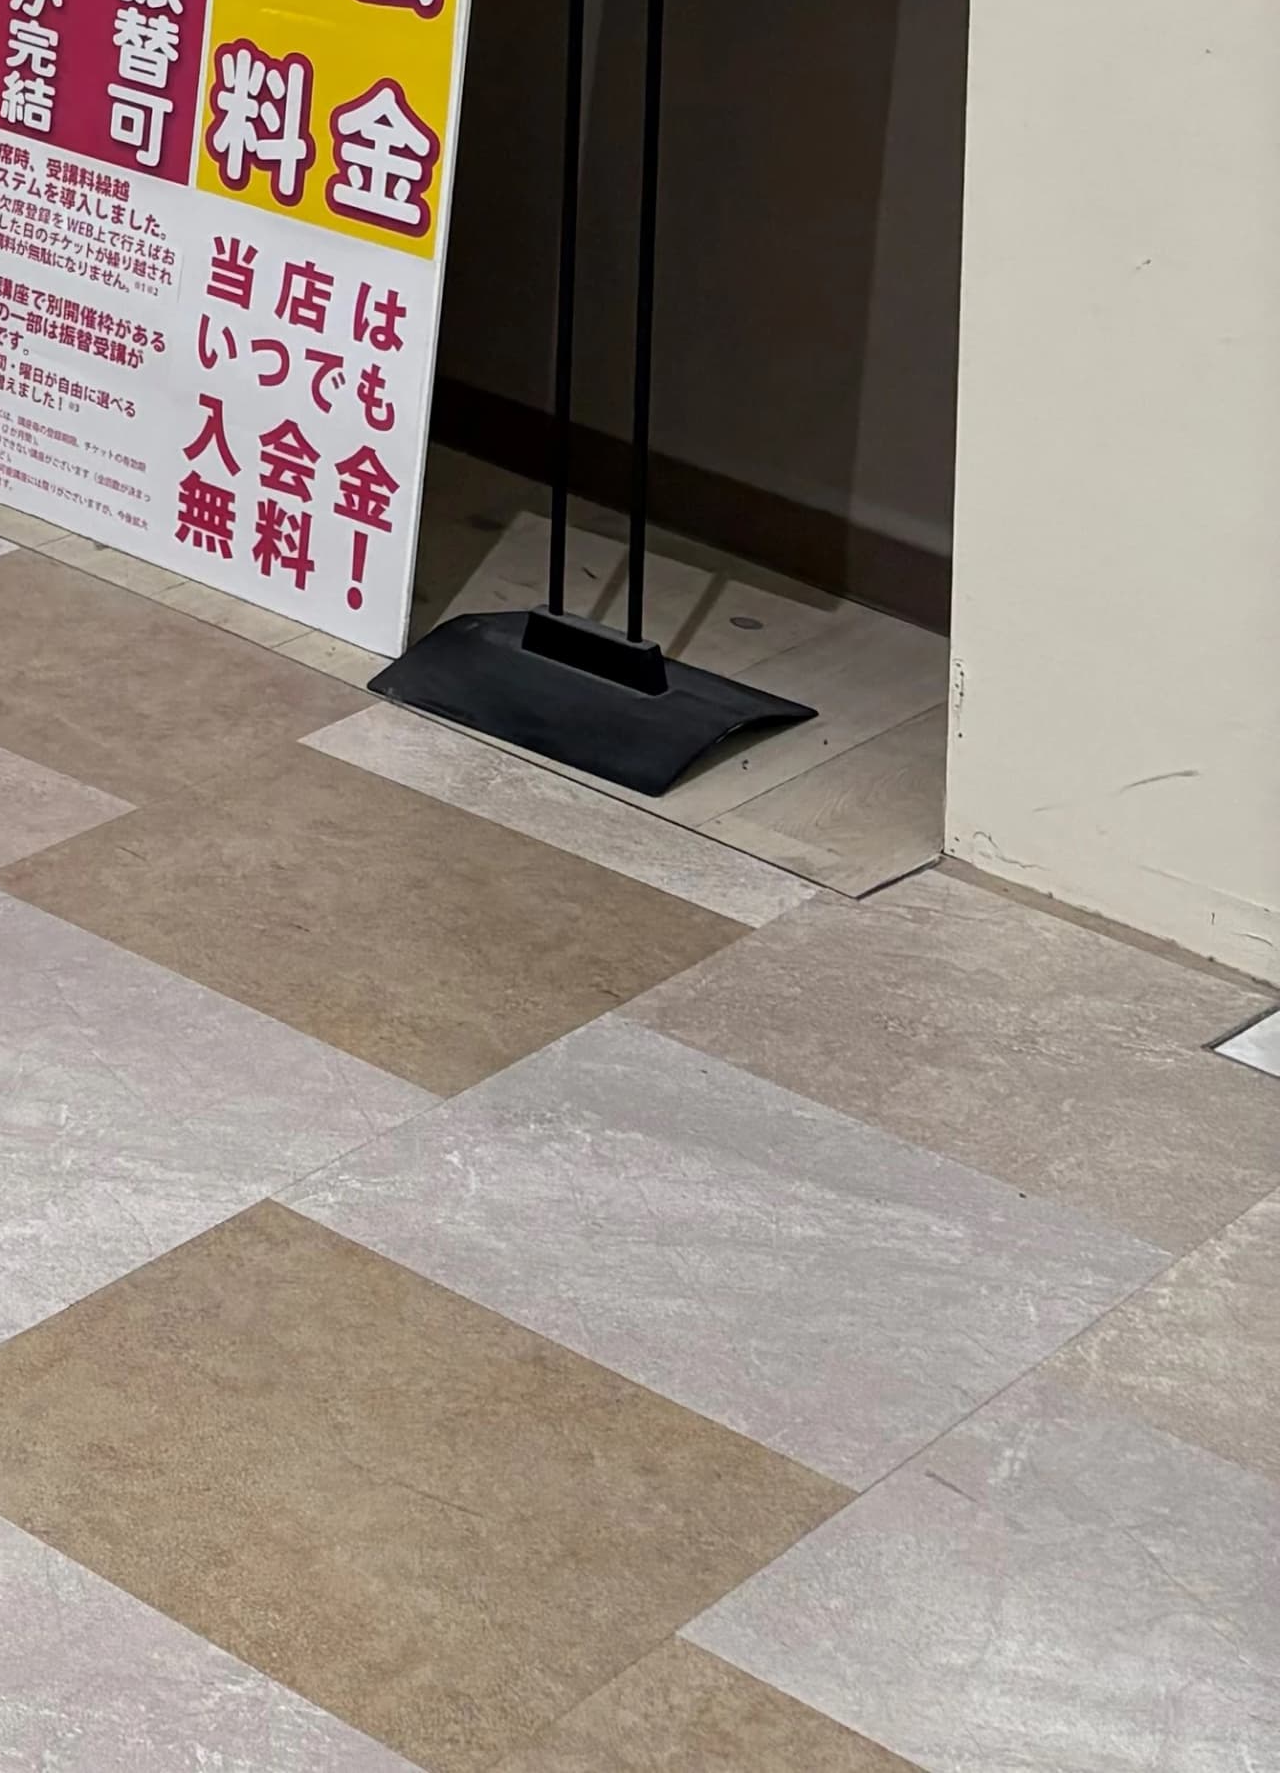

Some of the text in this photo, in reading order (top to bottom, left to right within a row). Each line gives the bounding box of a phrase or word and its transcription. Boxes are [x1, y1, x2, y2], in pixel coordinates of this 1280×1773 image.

[207, 236, 407, 353] 当店は
[197, 313, 395, 433] いつでも
[183, 393, 401, 534] 入会金
